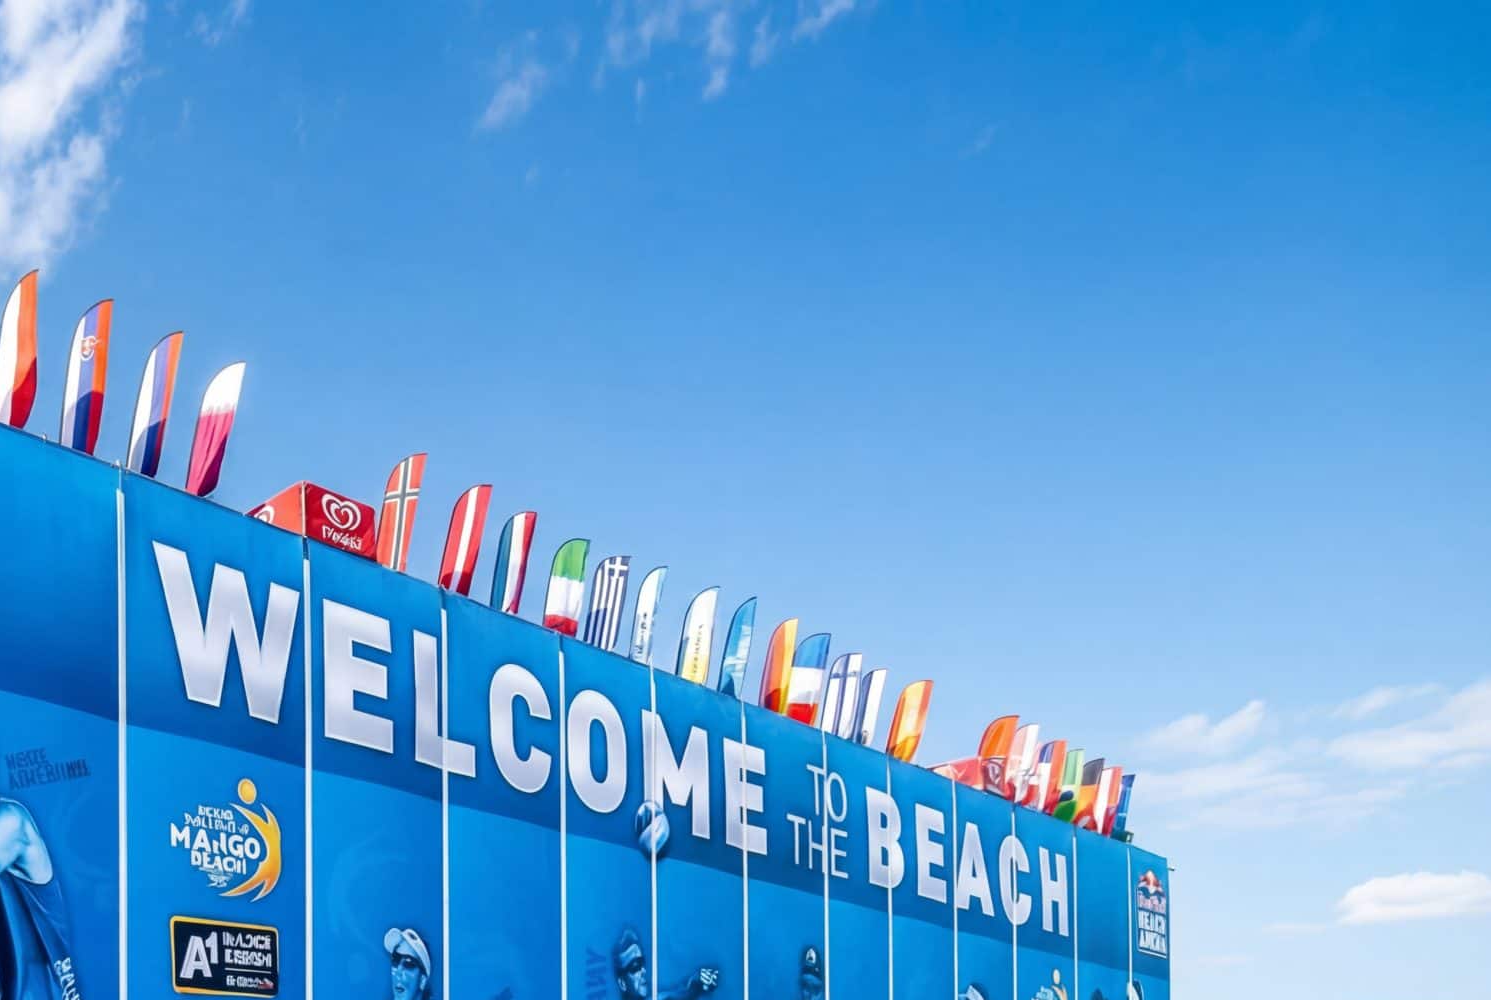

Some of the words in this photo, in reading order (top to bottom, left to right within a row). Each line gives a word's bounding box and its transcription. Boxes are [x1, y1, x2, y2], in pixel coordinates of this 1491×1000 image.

[152, 540, 768, 856] WELCOME
[806, 763, 848, 824] TO
[786, 814, 850, 879] THE
[865, 786, 1070, 938] BEACH
[179, 931, 219, 980] A1
